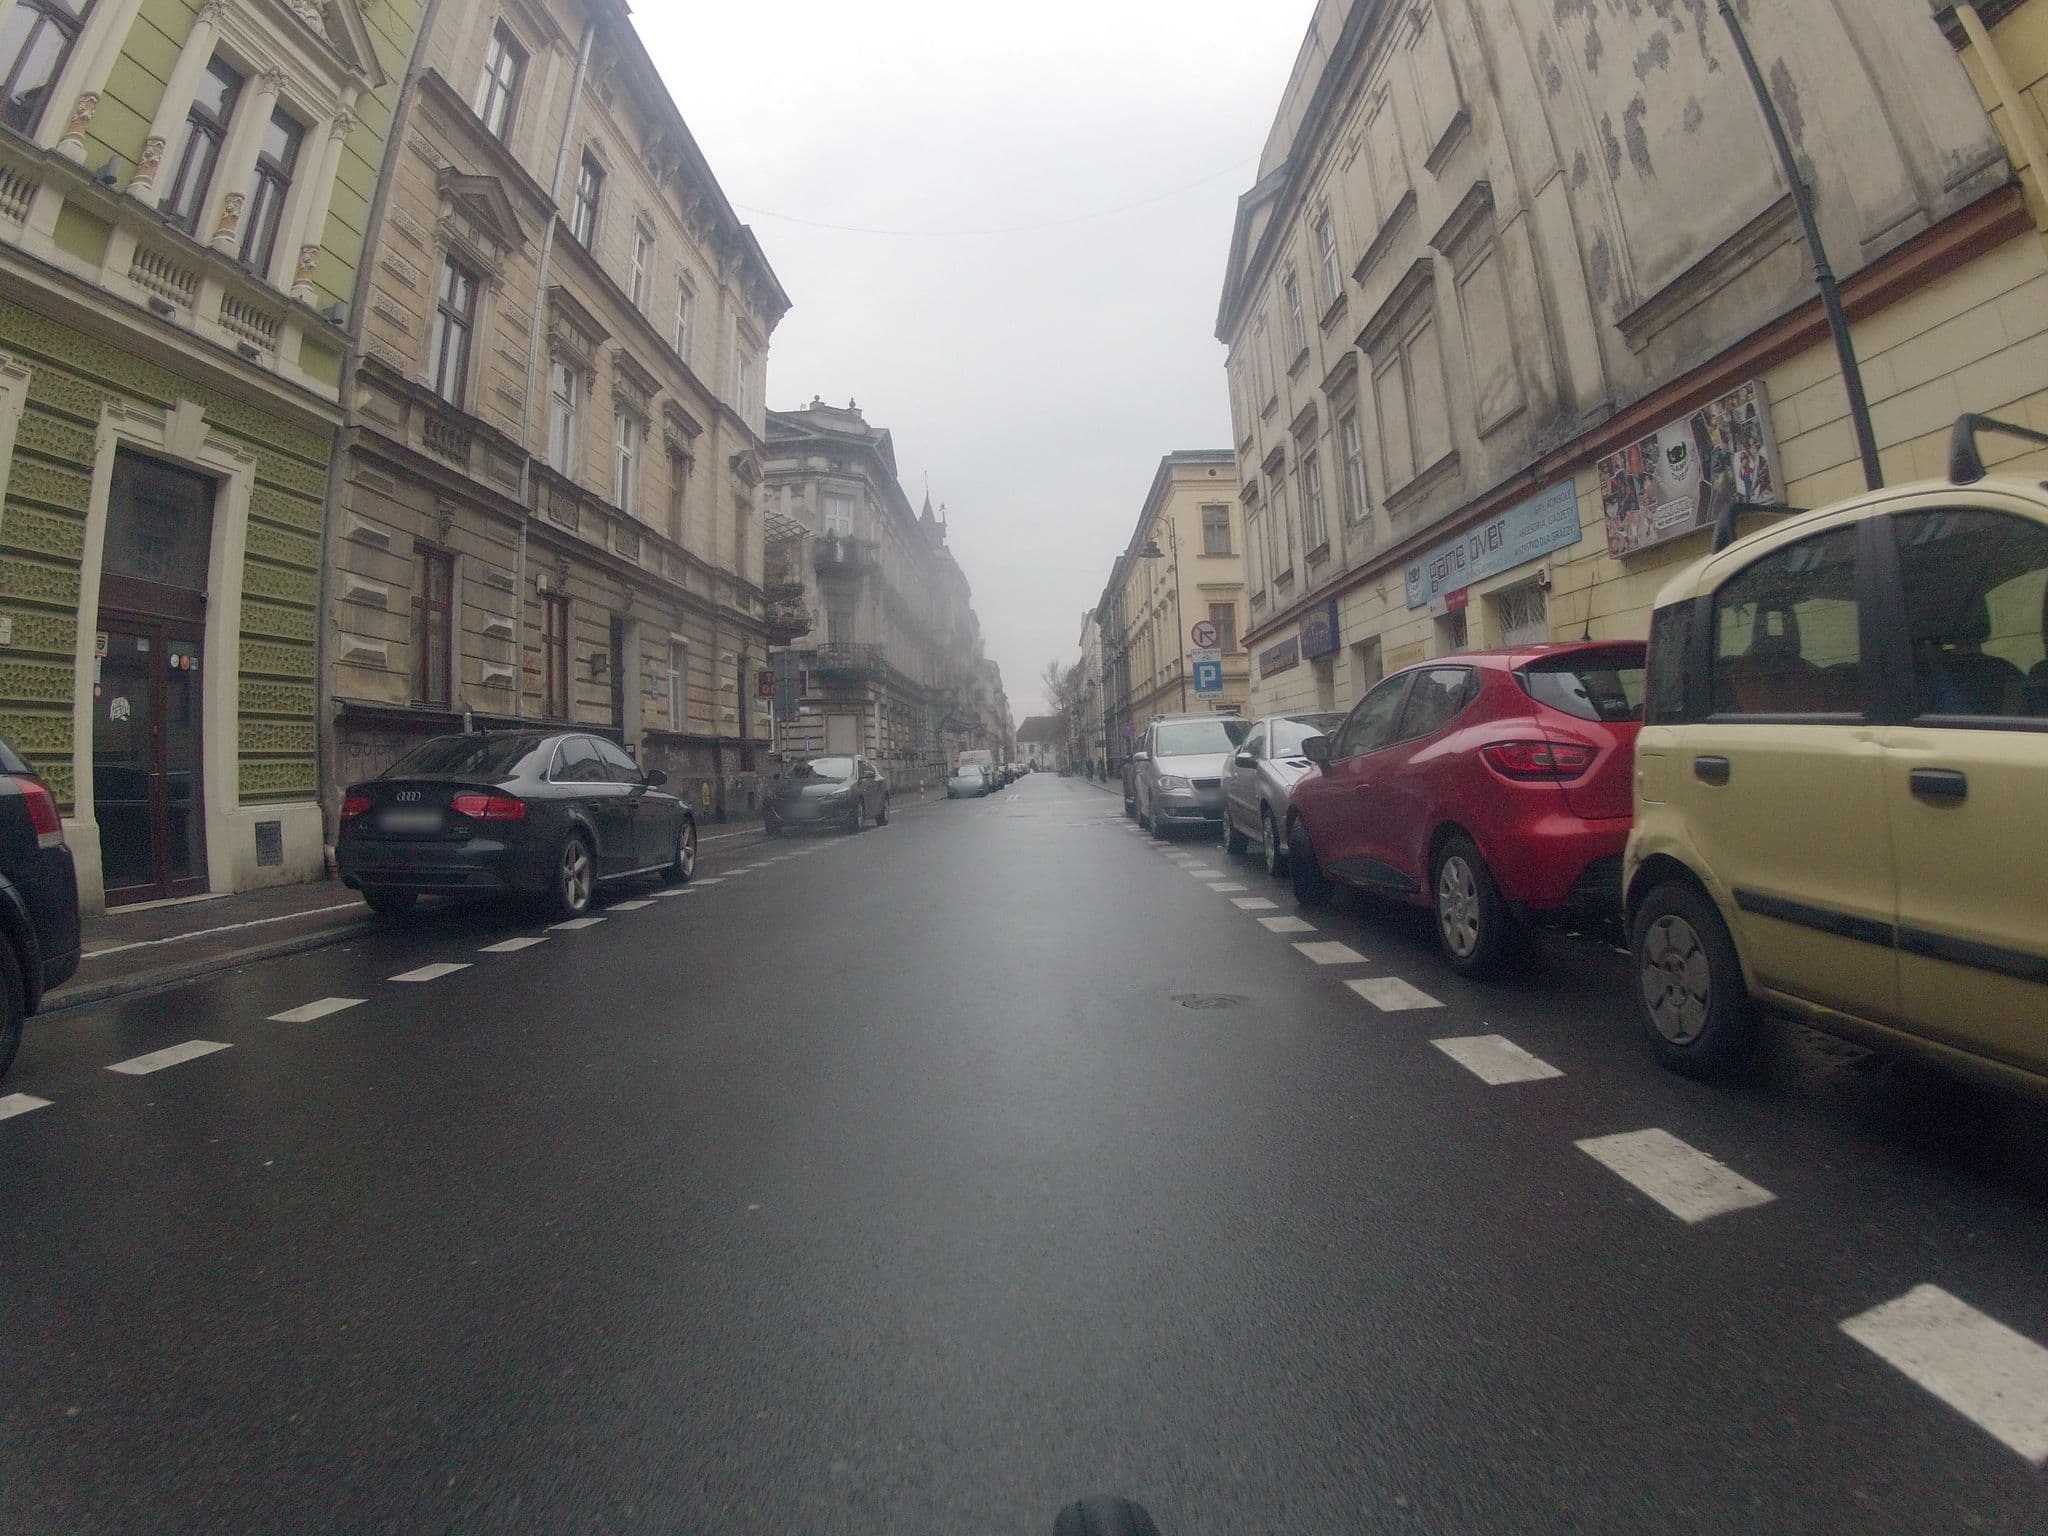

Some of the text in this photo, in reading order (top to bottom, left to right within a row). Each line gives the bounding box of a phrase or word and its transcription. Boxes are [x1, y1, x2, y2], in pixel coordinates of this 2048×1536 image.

[1429, 543, 1465, 593] game
[1469, 519, 1506, 561] over
[1199, 665, 1216, 688] P
